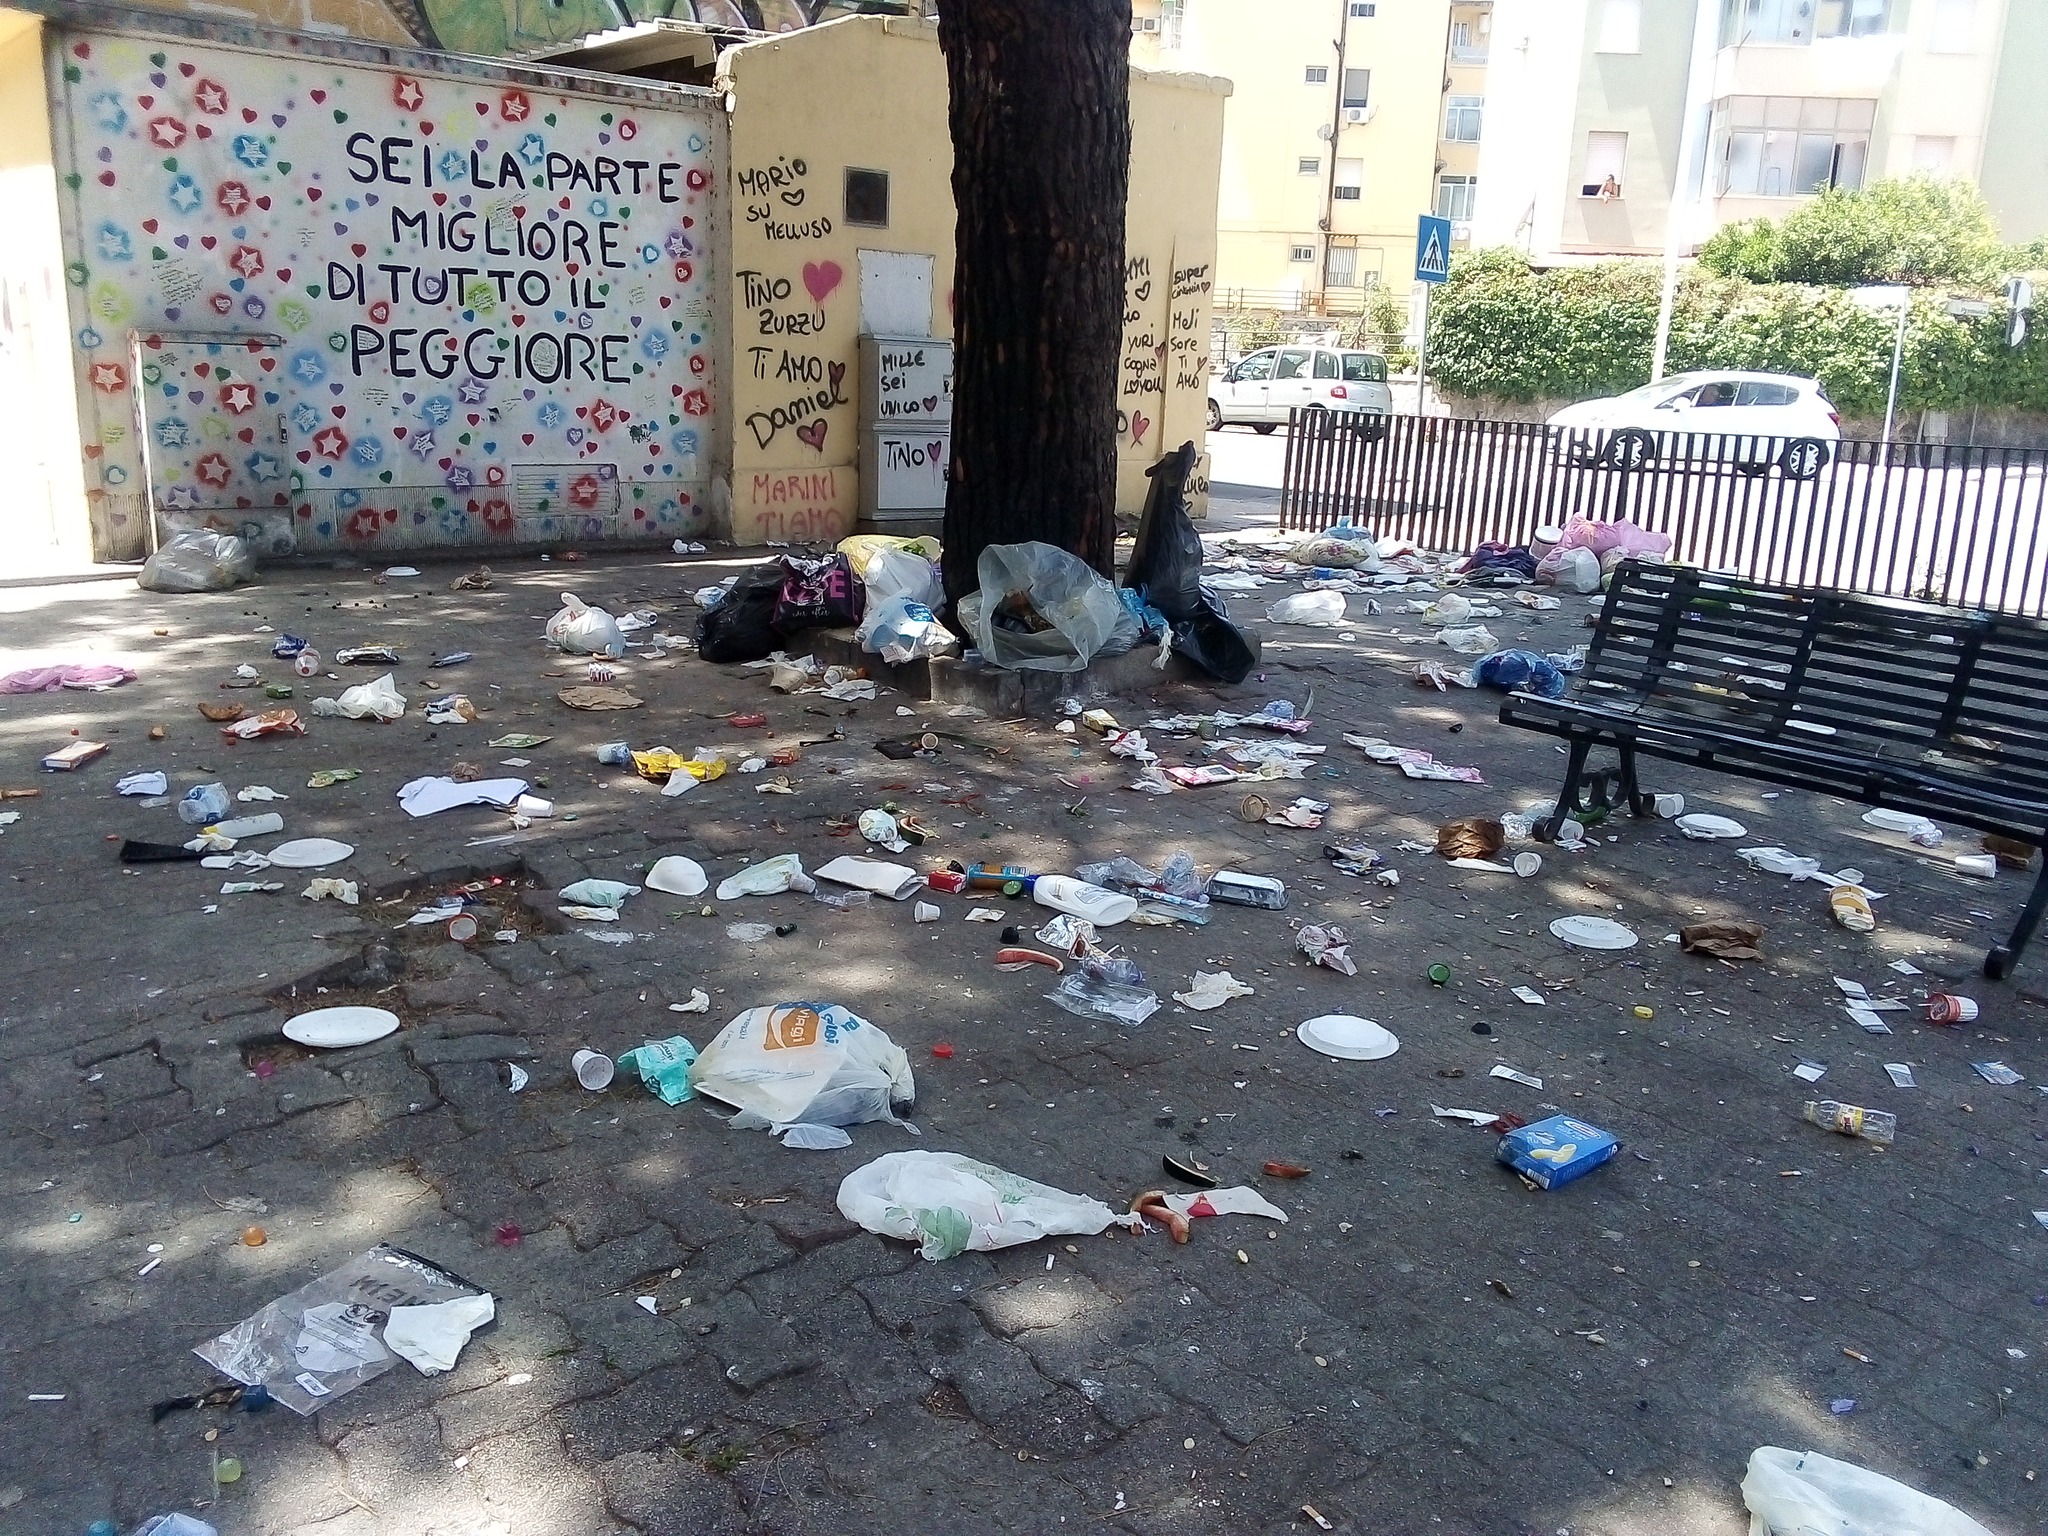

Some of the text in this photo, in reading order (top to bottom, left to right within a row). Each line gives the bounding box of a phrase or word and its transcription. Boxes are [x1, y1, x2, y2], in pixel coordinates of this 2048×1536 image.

[346, 132, 683, 203] SEI LA PARTE
[391, 205, 626, 268] MIGLIORE
[327, 261, 366, 306] DI
[569, 276, 606, 309] IL
[759, 308, 825, 336] ZURZU
[350, 323, 631, 384] PEGGIORE
[776, 349, 823, 383] AMO
[881, 349, 925, 373] MILLE
[880, 400, 920, 418] UNICO
[751, 469, 836, 505] MARINI
